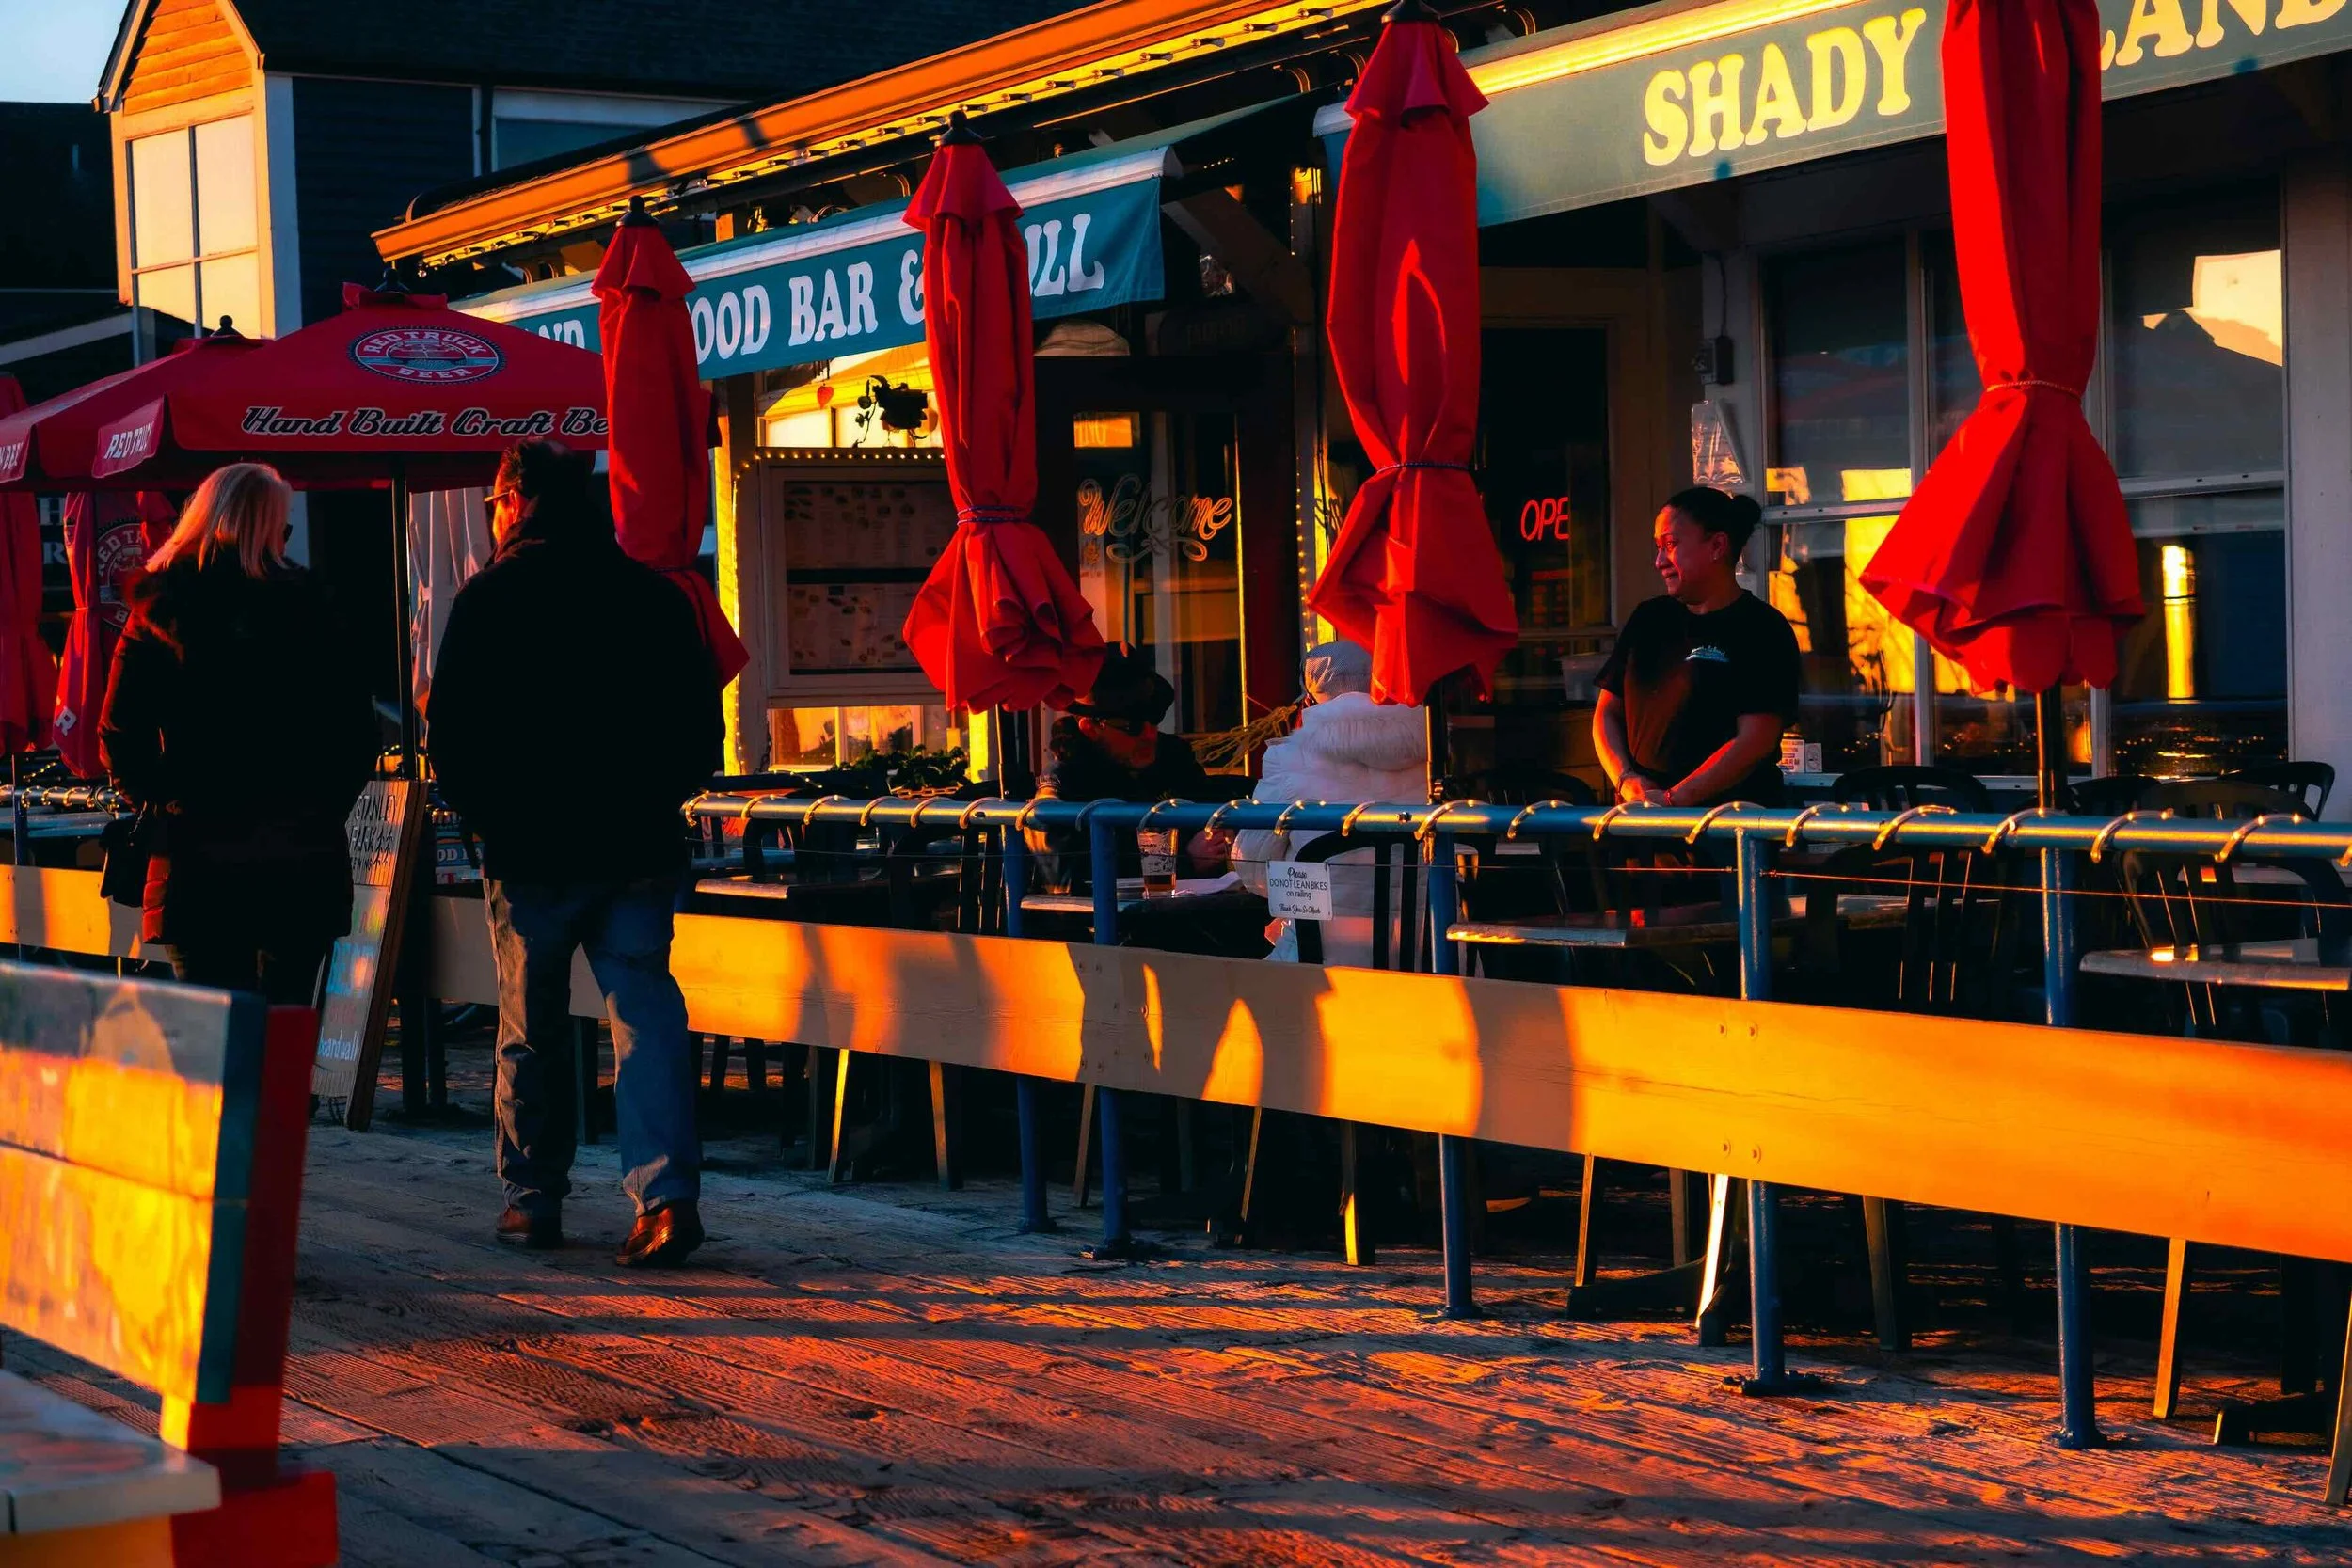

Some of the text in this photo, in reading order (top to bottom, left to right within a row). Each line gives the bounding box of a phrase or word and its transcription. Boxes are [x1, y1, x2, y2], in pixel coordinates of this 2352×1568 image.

[1644, 8, 1927, 166] SHADY
[691, 285, 771, 365] OOD
[788, 261, 879, 346] BAR
[1024, 213, 1105, 297] ILL
[363, 330, 487, 355] RED TRUCK
[396, 366, 473, 379] BEER
[241, 405, 609, 436] Hand Built Craft Be
[1077, 474, 1232, 544] Welcome
[1520, 496, 1570, 542] OPE
[1269, 879, 1327, 891] DO NOT LEAN BIKES
[1287, 866, 1308, 879] Please
[1295, 889, 1311, 900] railing
[1279, 903, 1291, 912] Thank
[1292, 904, 1302, 914] You
